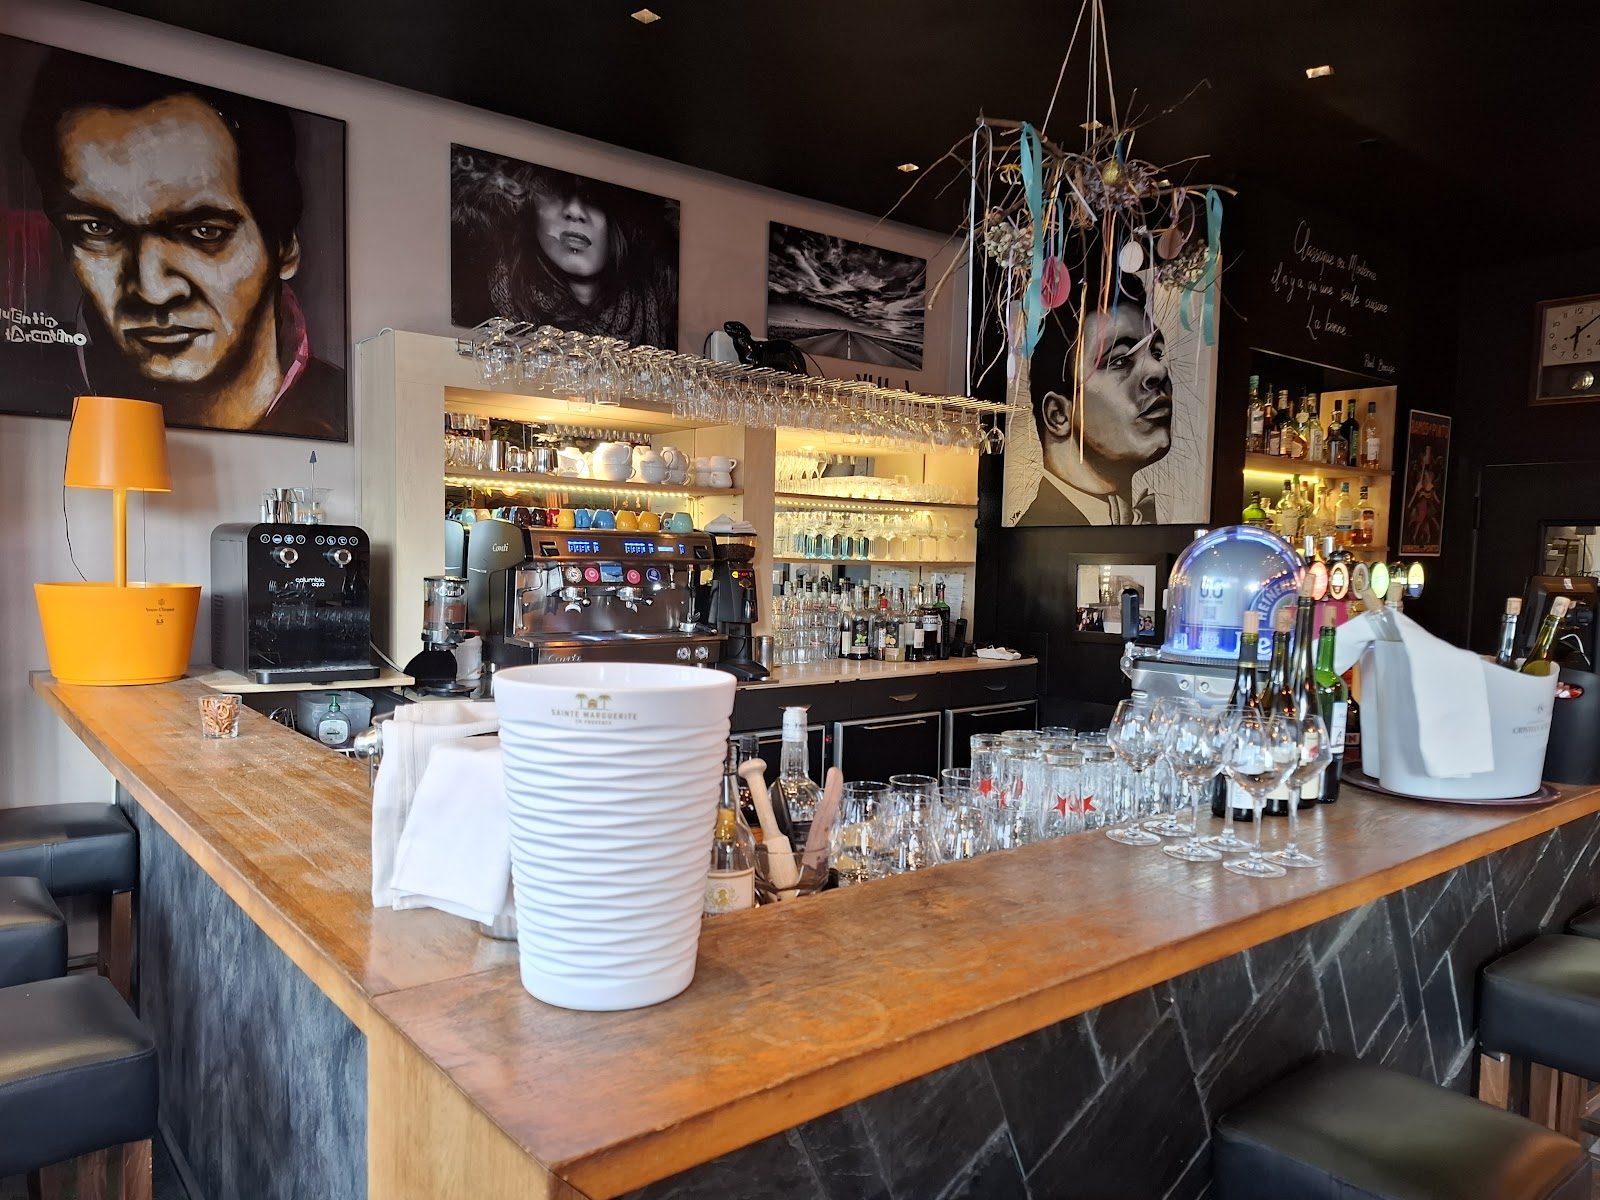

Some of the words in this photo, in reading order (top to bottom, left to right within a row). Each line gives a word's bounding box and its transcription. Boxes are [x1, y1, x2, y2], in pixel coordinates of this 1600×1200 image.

[0, 307, 59, 329] uEntin
[551, 708, 579, 718] SAINTE
[583, 710, 638, 721] MARGUERITE
